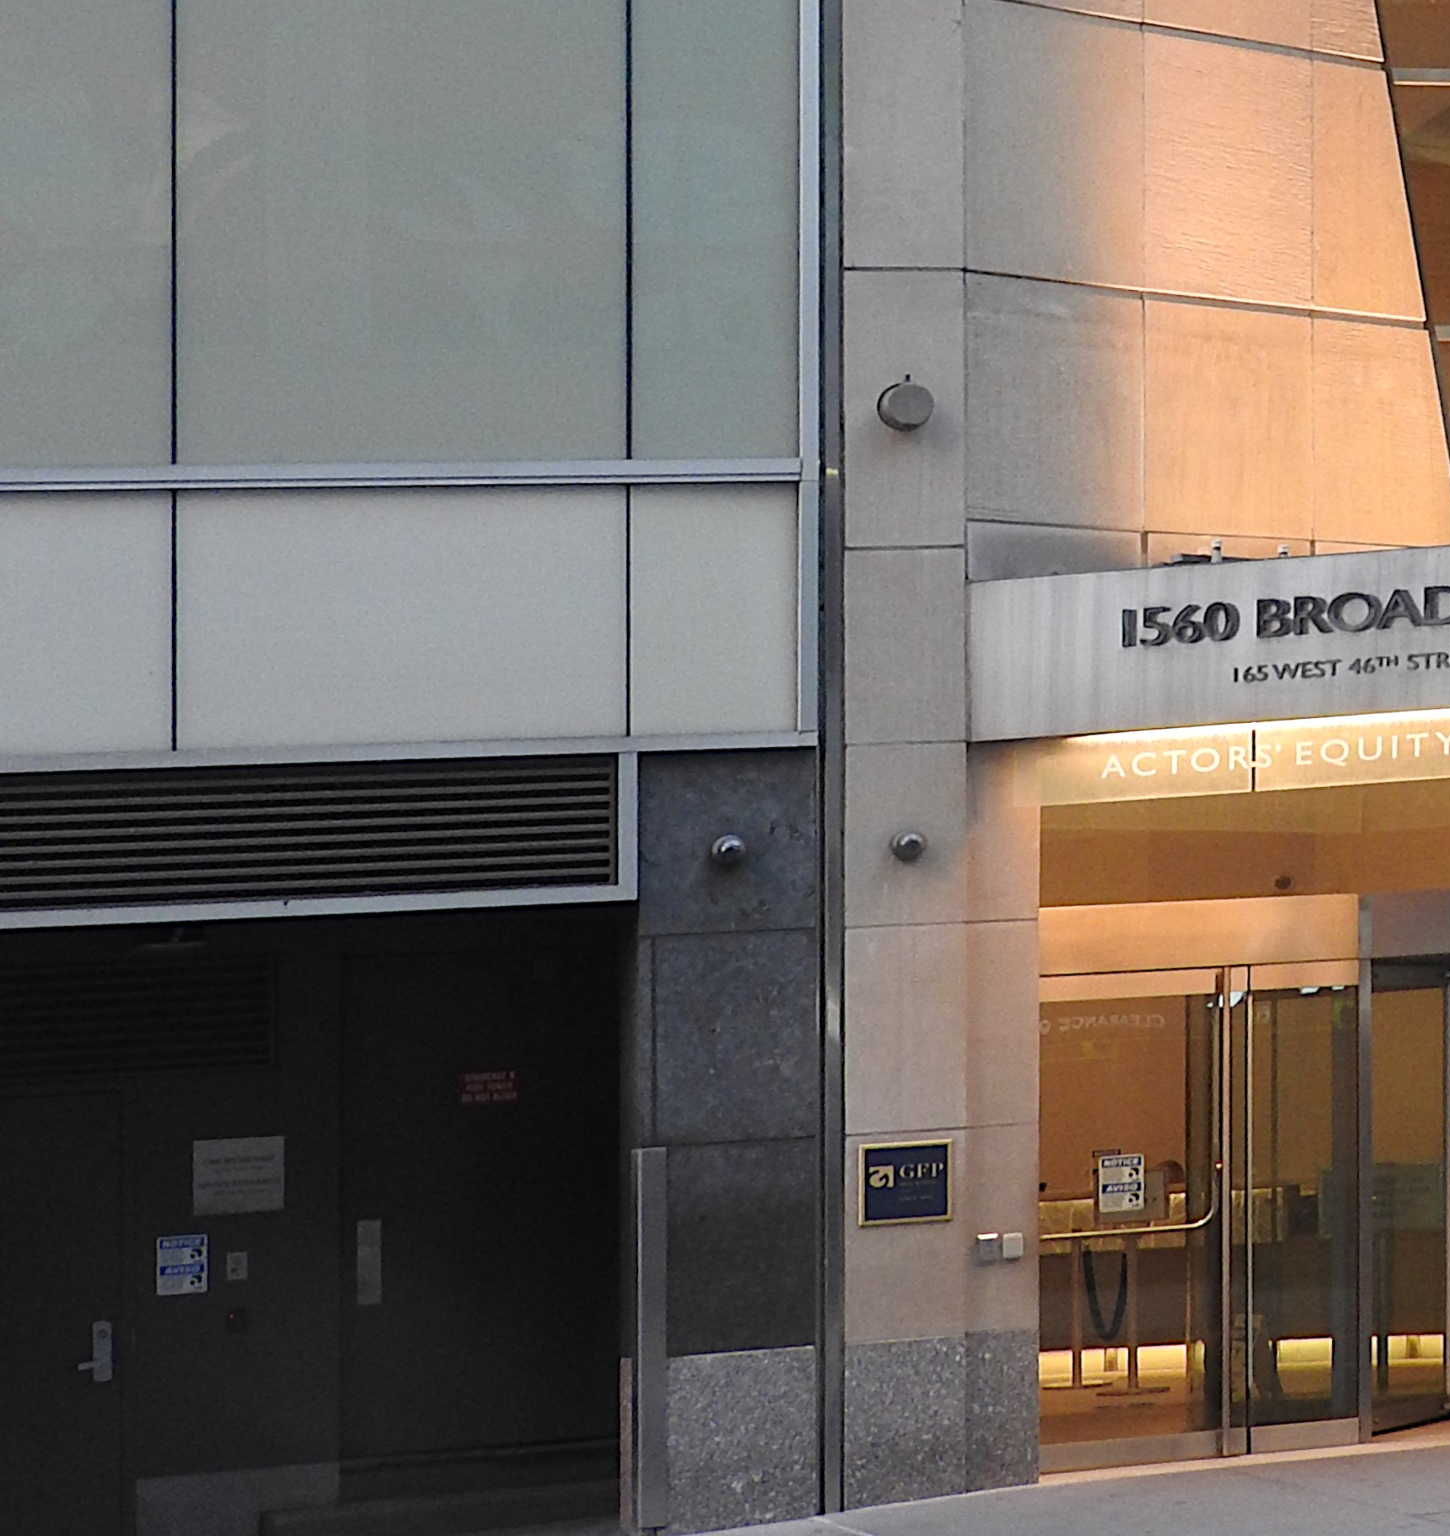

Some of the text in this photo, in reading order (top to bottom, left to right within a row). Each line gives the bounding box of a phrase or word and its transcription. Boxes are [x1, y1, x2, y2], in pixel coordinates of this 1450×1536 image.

[1121, 602, 1240, 648] 1560
[1232, 664, 1269, 684] 165
[1273, 659, 1341, 681] WEST
[1348, 655, 1399, 676] 46TH
[1101, 743, 1282, 780] ACTORS'
[899, 1162, 944, 1179] GFP
[1103, 1158, 1139, 1167] NOTICE
